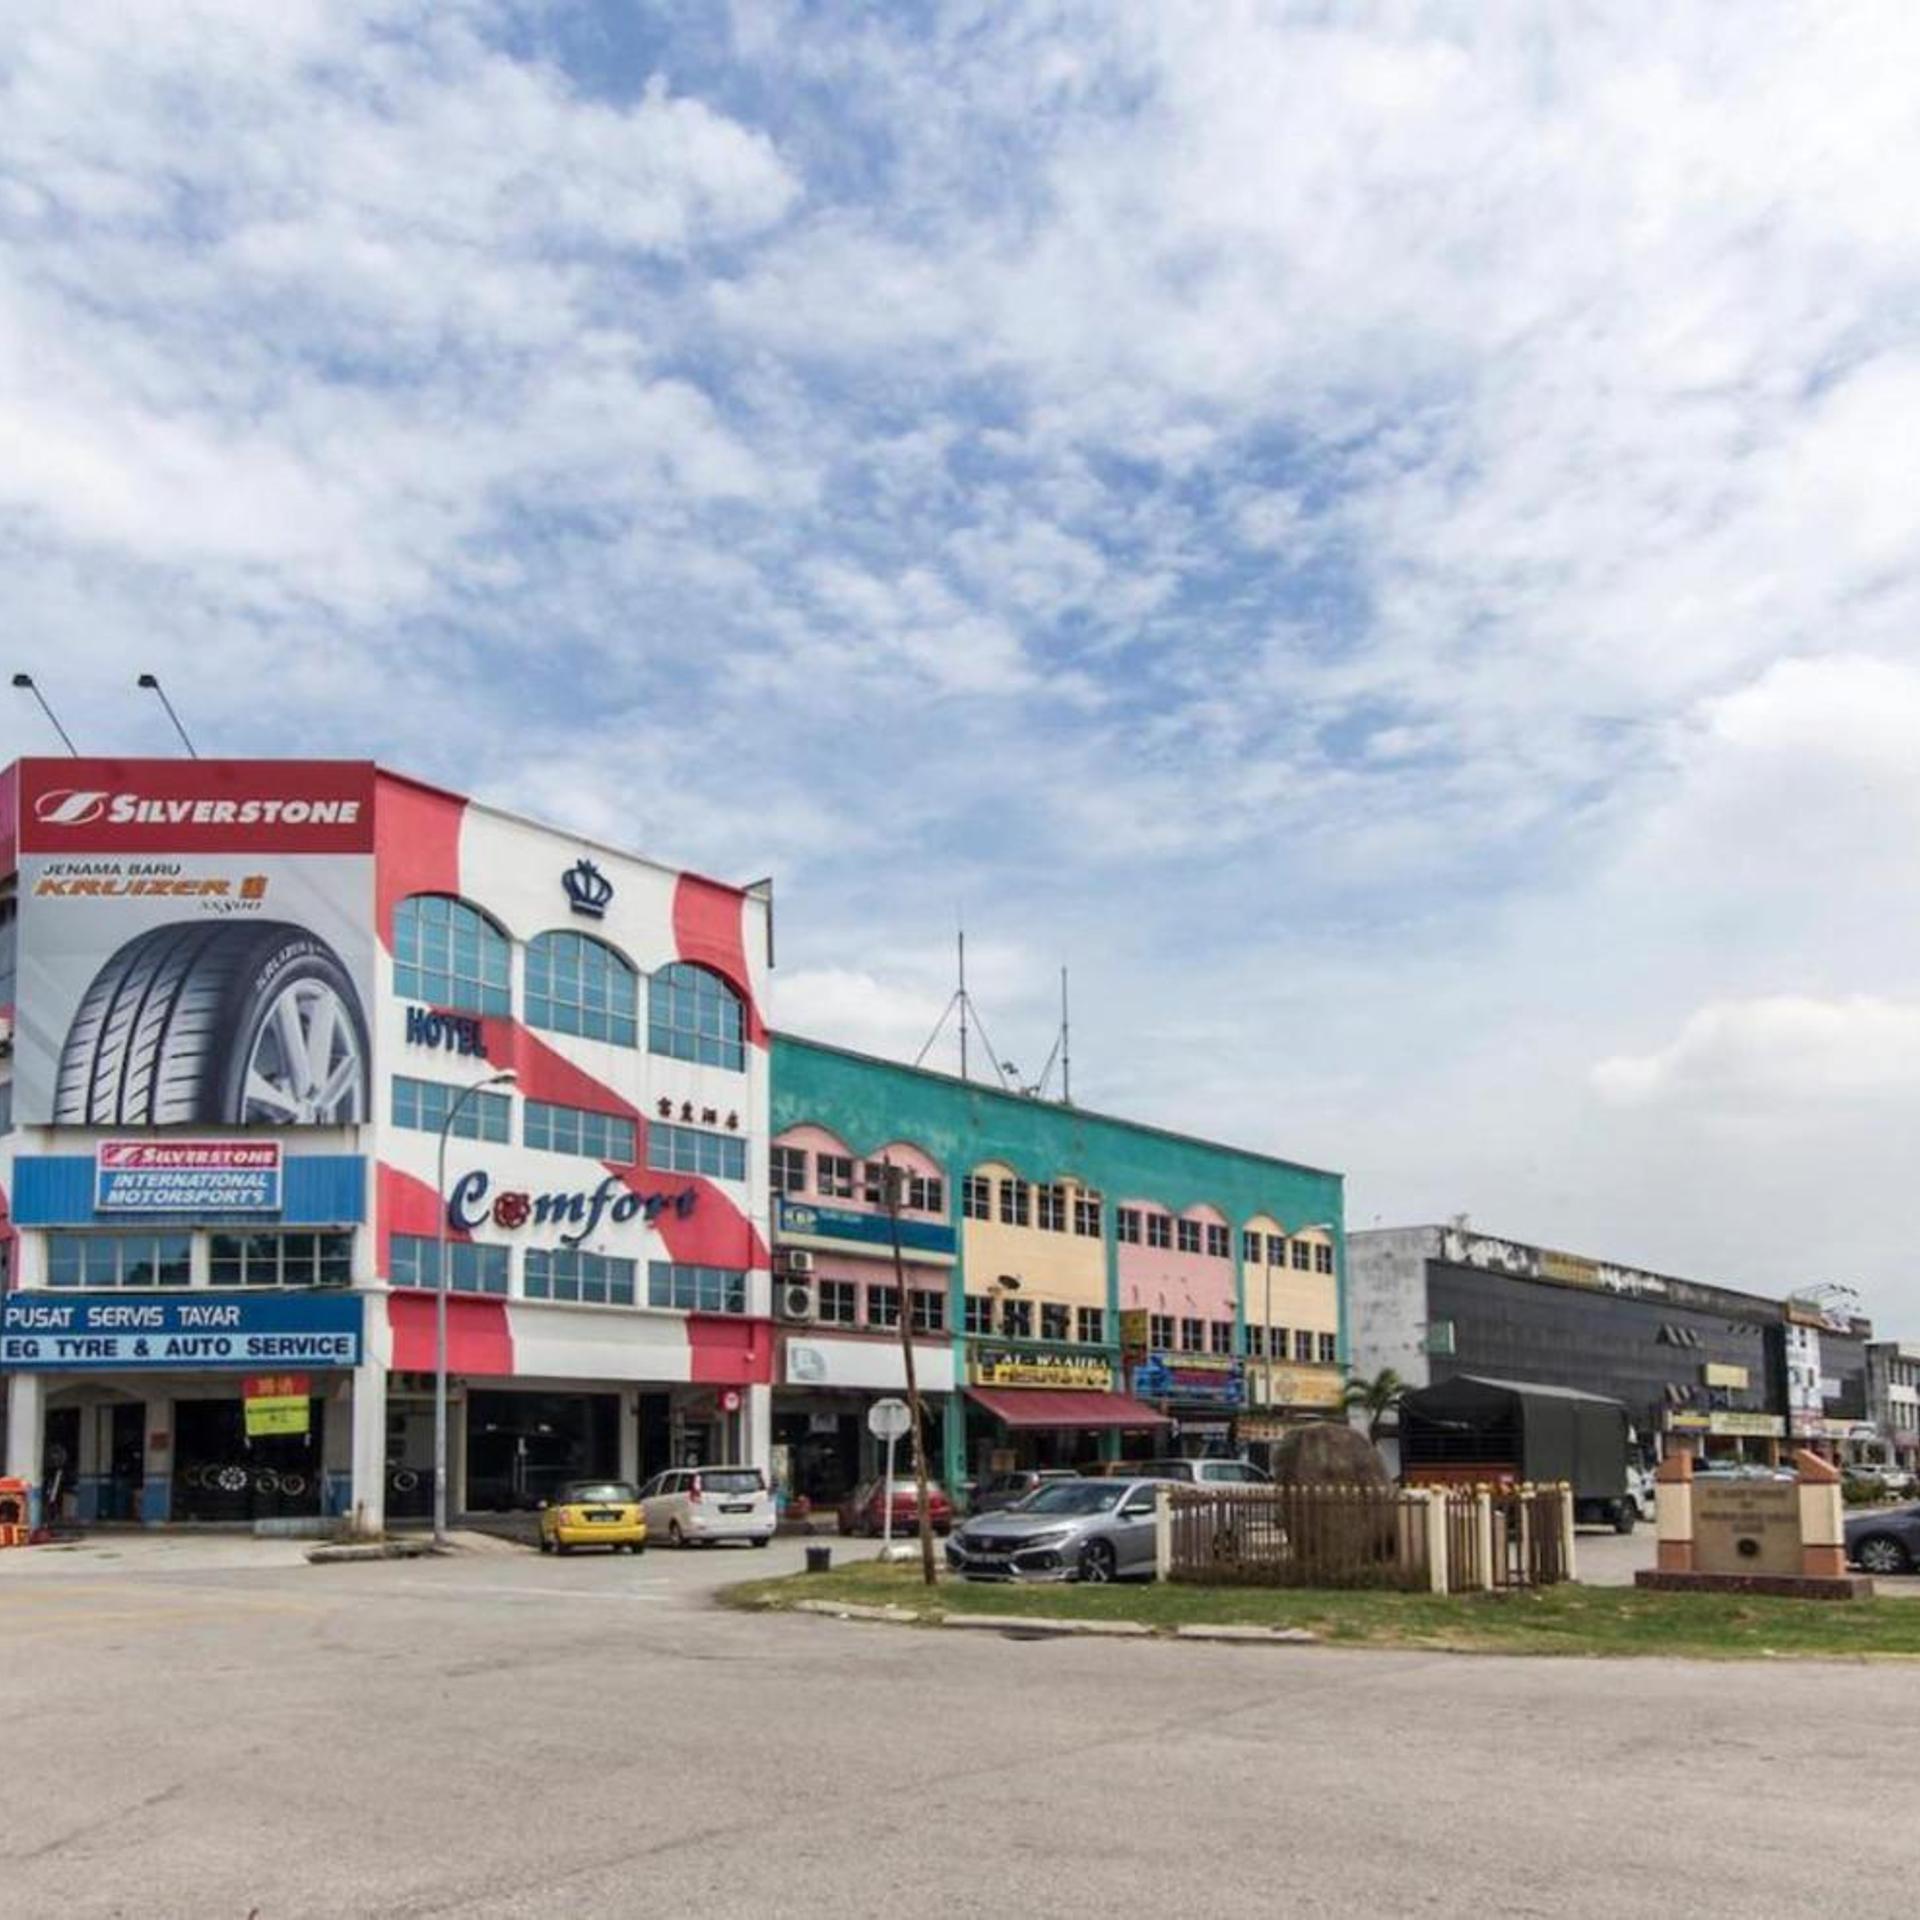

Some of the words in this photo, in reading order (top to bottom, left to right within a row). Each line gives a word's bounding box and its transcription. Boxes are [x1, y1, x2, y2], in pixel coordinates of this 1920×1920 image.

[108, 794, 359, 823] SILVERSTONE
[43, 863, 122, 876] JENAMA
[128, 863, 181, 876] BARU
[35, 878, 231, 896] KRUIZER
[406, 1006, 488, 1059] HOTEL
[142, 1148, 275, 1164] SILVERSTONE
[112, 1173, 269, 1188] INTERNATIONAL
[107, 1189, 264, 1204] MOTORSPORTS
[5, 1306, 74, 1328] PUSAT
[87, 1305, 165, 1328] SERVIS
[177, 1305, 241, 1327] TAYAR
[6, 1338, 40, 1358] EG
[56, 1338, 119, 1357] TYRE
[133, 1337, 150, 1356] &
[165, 1337, 232, 1357] AUTO
[247, 1336, 350, 1356] SERVICE
